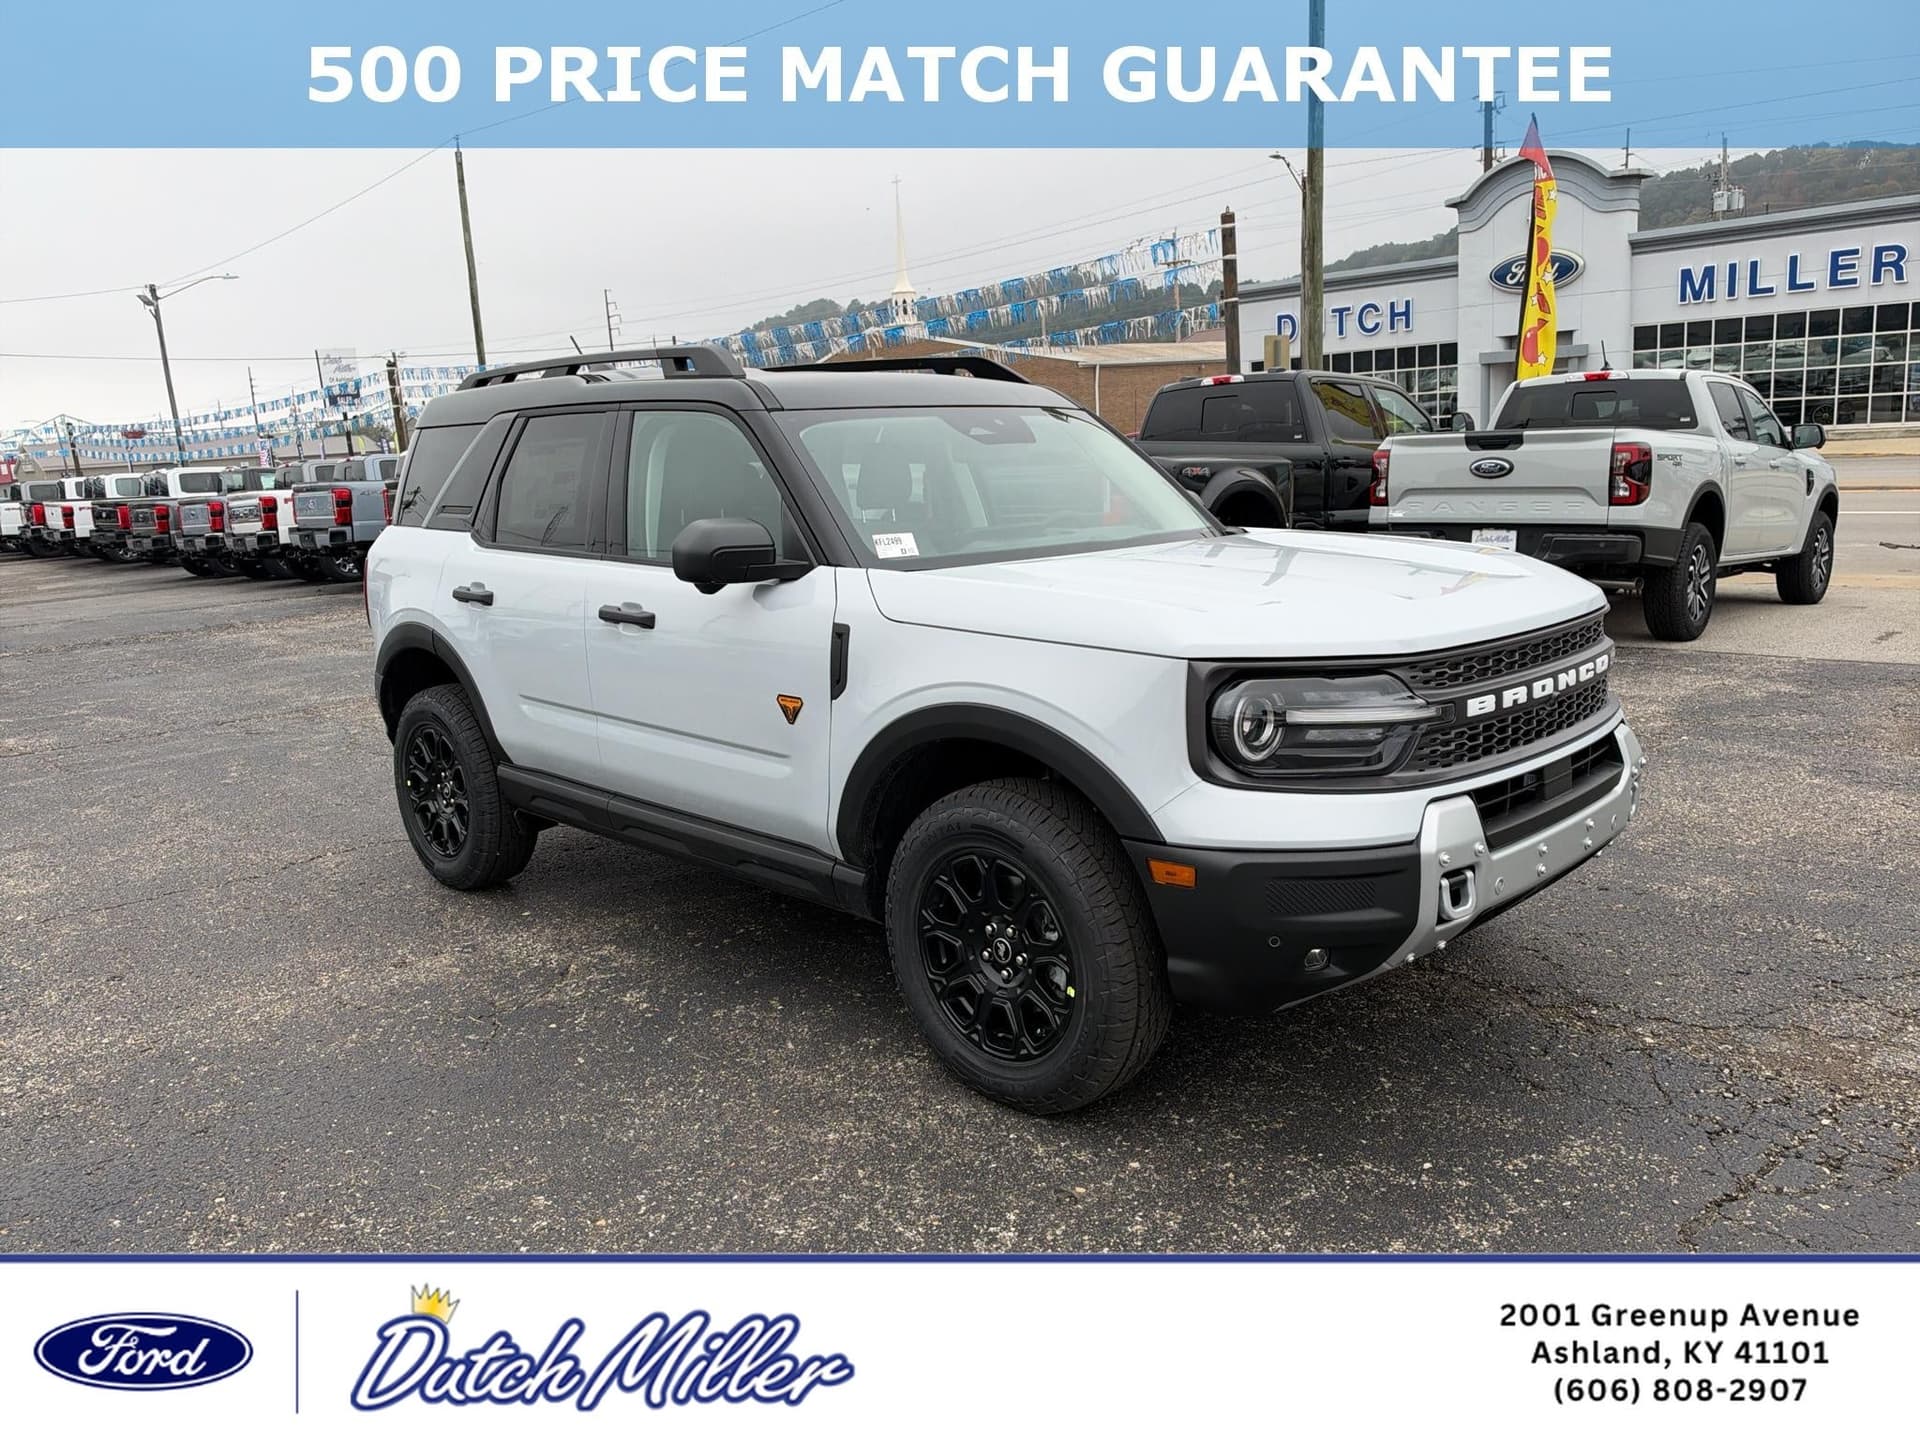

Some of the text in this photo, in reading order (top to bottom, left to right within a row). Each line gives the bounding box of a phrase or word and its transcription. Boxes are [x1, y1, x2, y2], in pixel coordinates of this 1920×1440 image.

[1678, 243, 1909, 305] MILLER
[1275, 298, 1413, 343] DTCH
[1466, 654, 1609, 718] BRONCO
